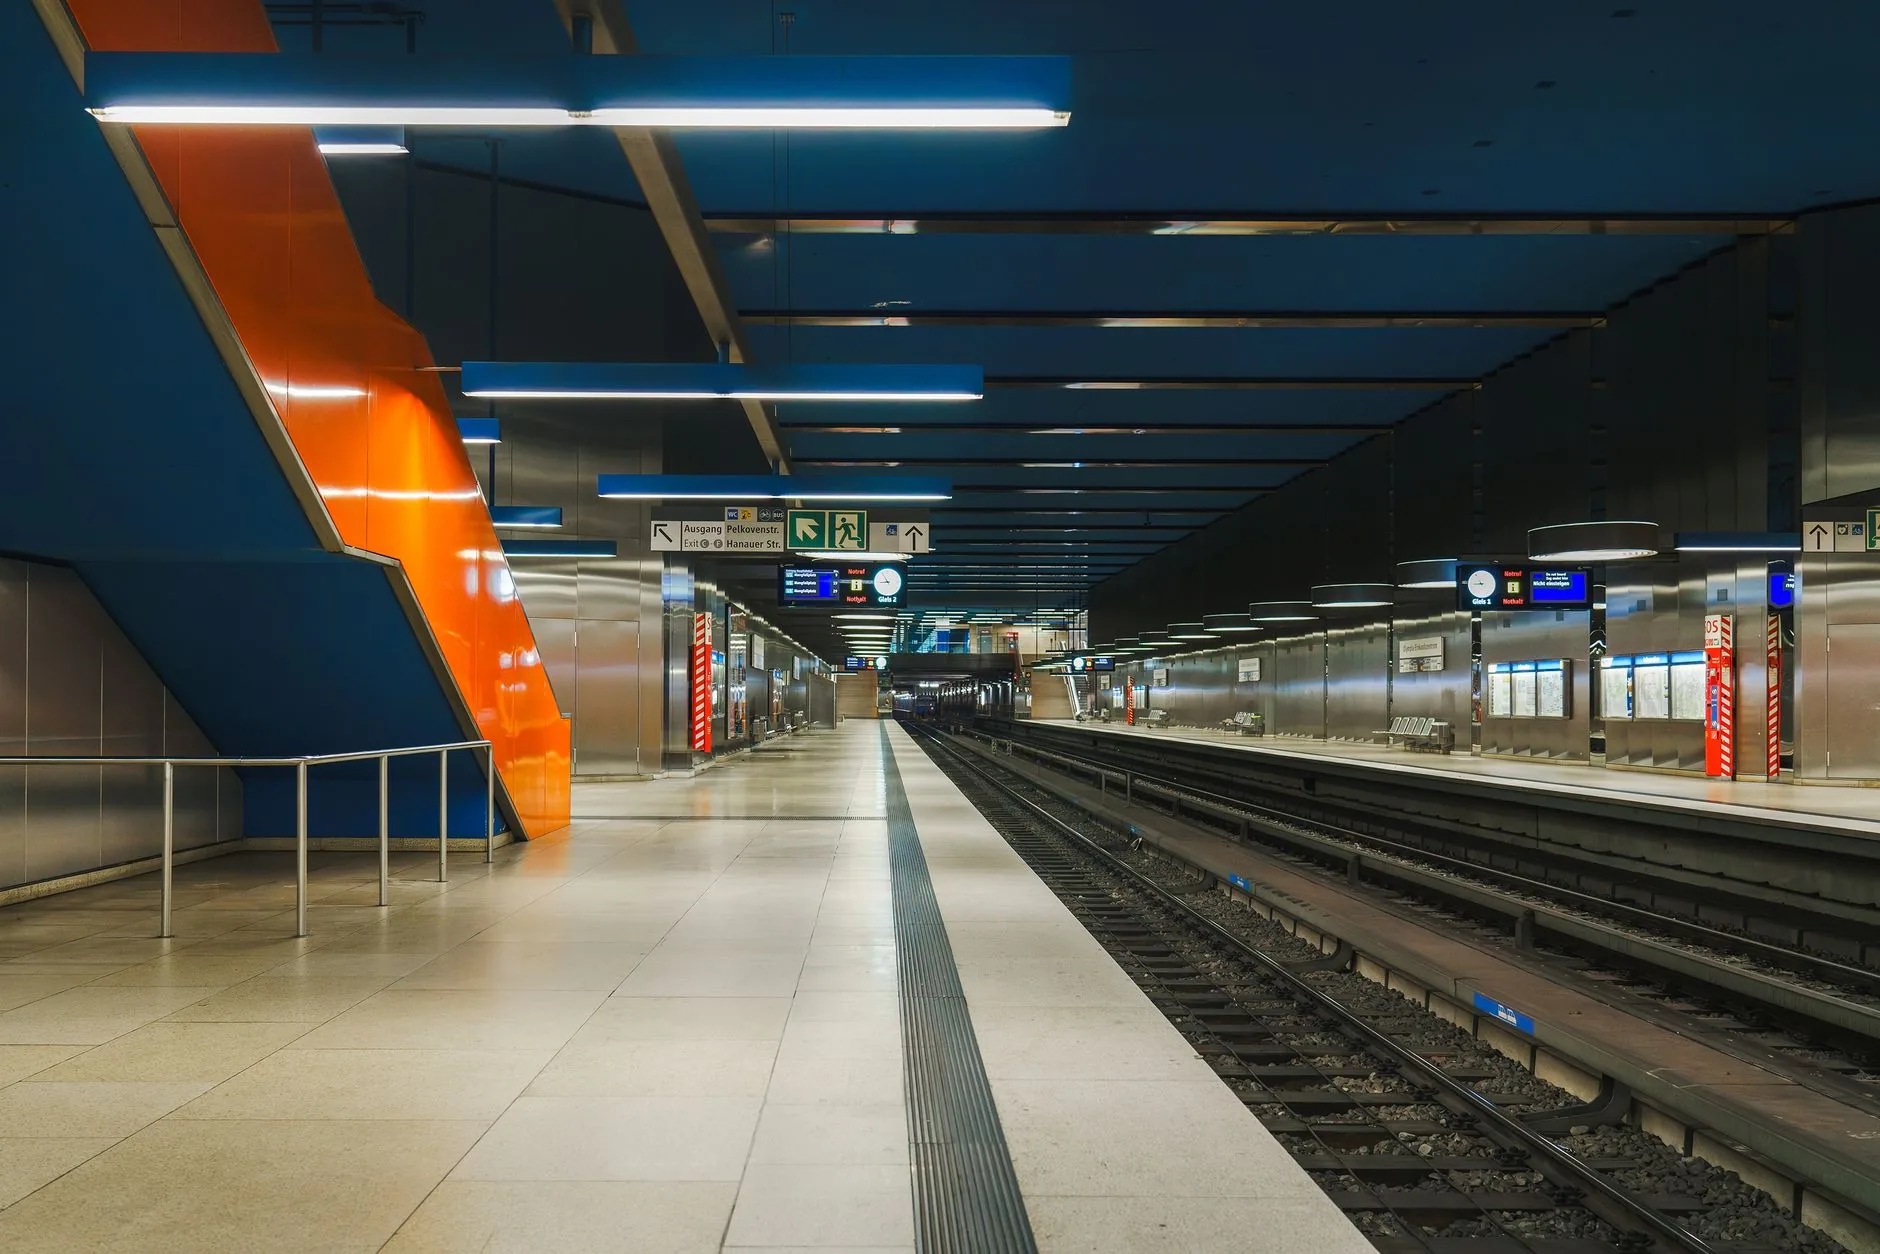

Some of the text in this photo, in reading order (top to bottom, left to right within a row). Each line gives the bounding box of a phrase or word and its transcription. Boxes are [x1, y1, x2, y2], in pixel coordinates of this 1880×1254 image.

[684, 525, 722, 535] Ausgang
[727, 525, 780, 534] Pelkovenstr.
[684, 539, 699, 548] Exit
[726, 540, 781, 548] Hanauer Str.
[1705, 619, 1719, 633] OS
